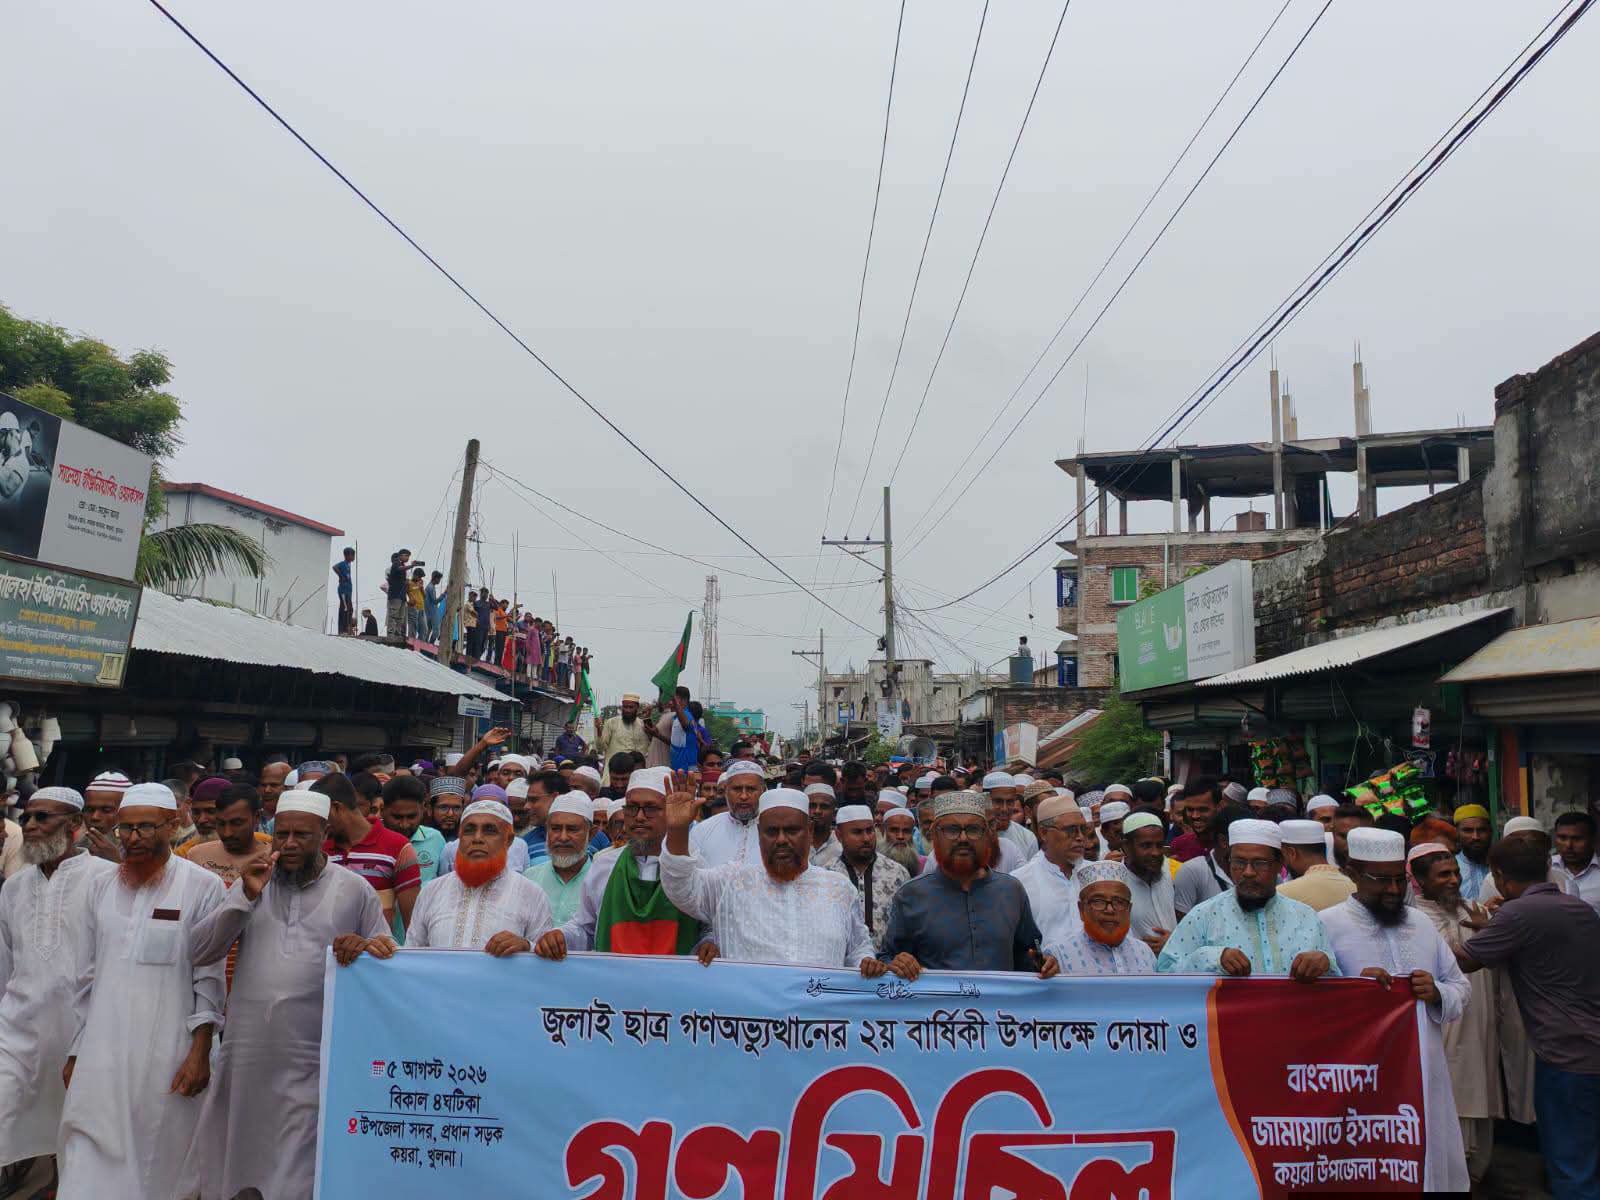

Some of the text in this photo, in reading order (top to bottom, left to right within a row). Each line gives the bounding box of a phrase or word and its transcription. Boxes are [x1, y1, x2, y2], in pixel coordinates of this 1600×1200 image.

[541, 998, 1198, 1058] জুলাই ছাত্র গণঅভ্যুত্থানের ২য় বার্ষিকী উপলক্ষে দোয়া ও
[386, 1059, 487, 1085] ৫ আগস্ট ২০২৬
[1286, 1064, 1379, 1093] বাংলাদেশ
[389, 1085, 429, 1110] বিকাল
[359, 1115, 505, 1146] উপজেলা সদর, প্রধান সড়ক
[1251, 1104, 1421, 1152] জামায়াতে ইসলামী
[389, 1146, 423, 1168] কয়রা,
[1272, 1154, 1419, 1189] কয়রা উপজেলা শাখা
